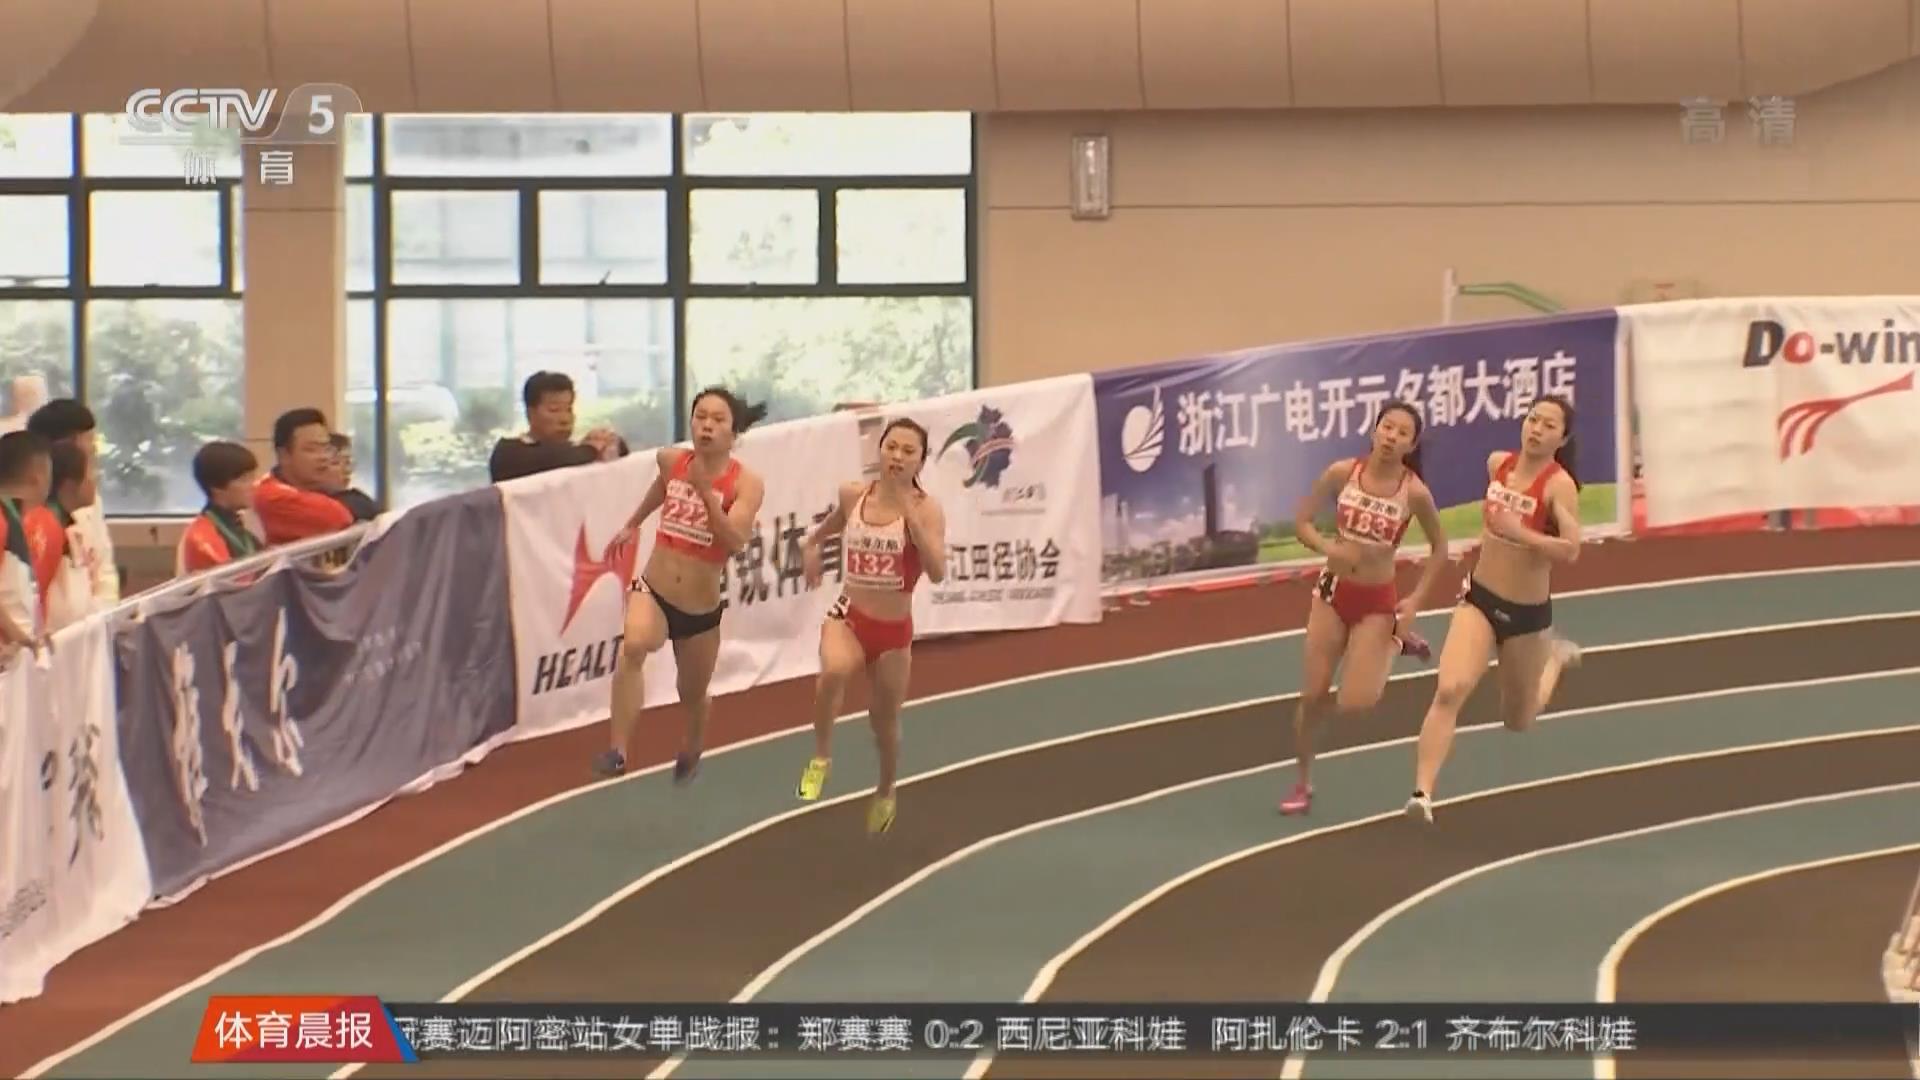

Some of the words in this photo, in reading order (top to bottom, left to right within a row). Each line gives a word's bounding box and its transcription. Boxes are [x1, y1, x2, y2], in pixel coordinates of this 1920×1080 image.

[1177, 350, 1577, 456] 浙江广电开元名都大酒店
[852, 552, 896, 576] 132
